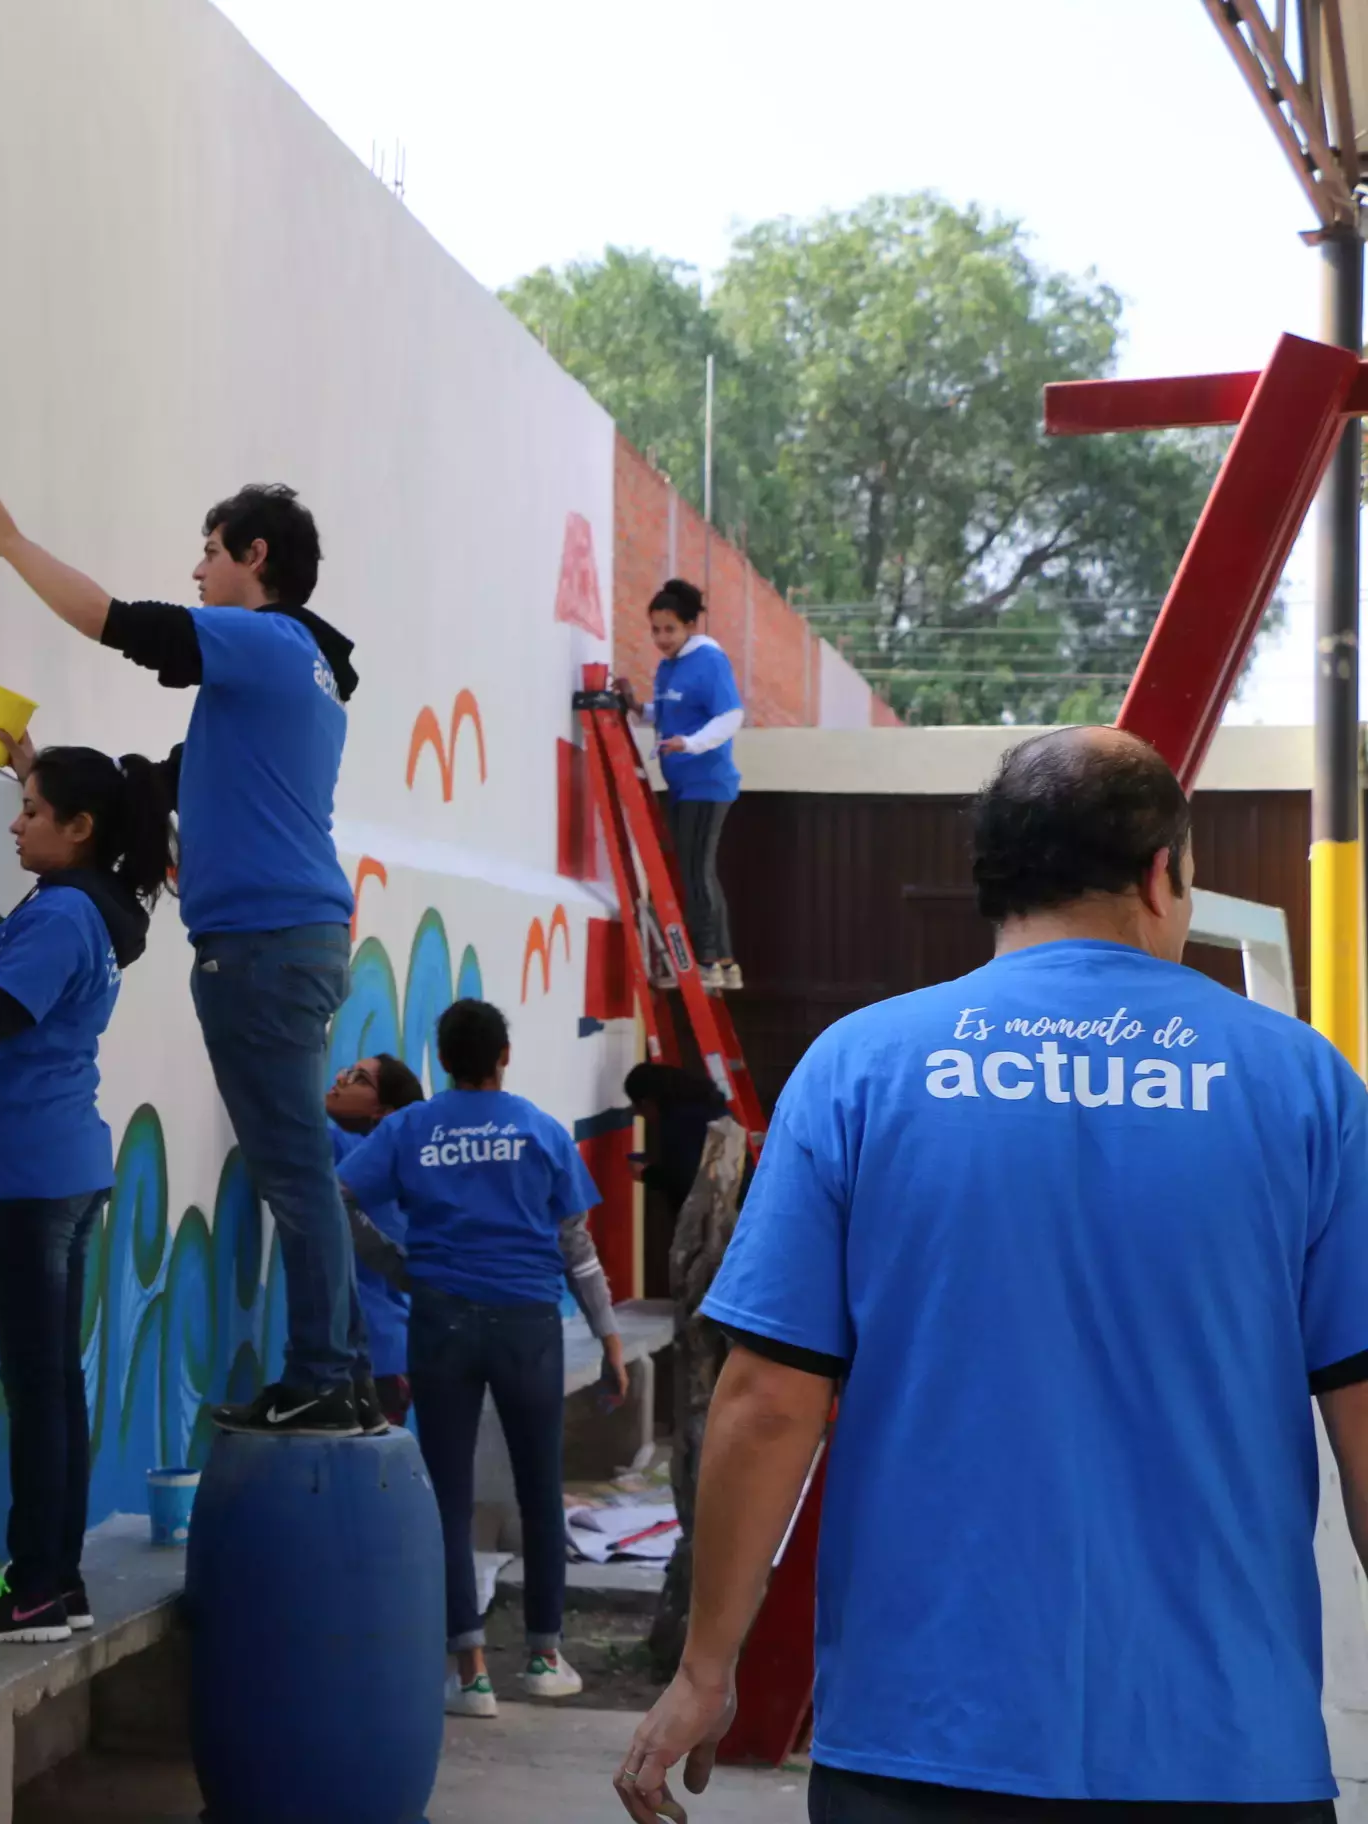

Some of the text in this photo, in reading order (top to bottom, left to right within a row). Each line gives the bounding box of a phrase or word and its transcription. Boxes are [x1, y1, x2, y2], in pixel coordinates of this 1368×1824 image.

[953, 1007, 1199, 1049] Es momento de
[925, 1041, 1226, 1112] actuar
[419, 1136, 528, 1167] actuar
